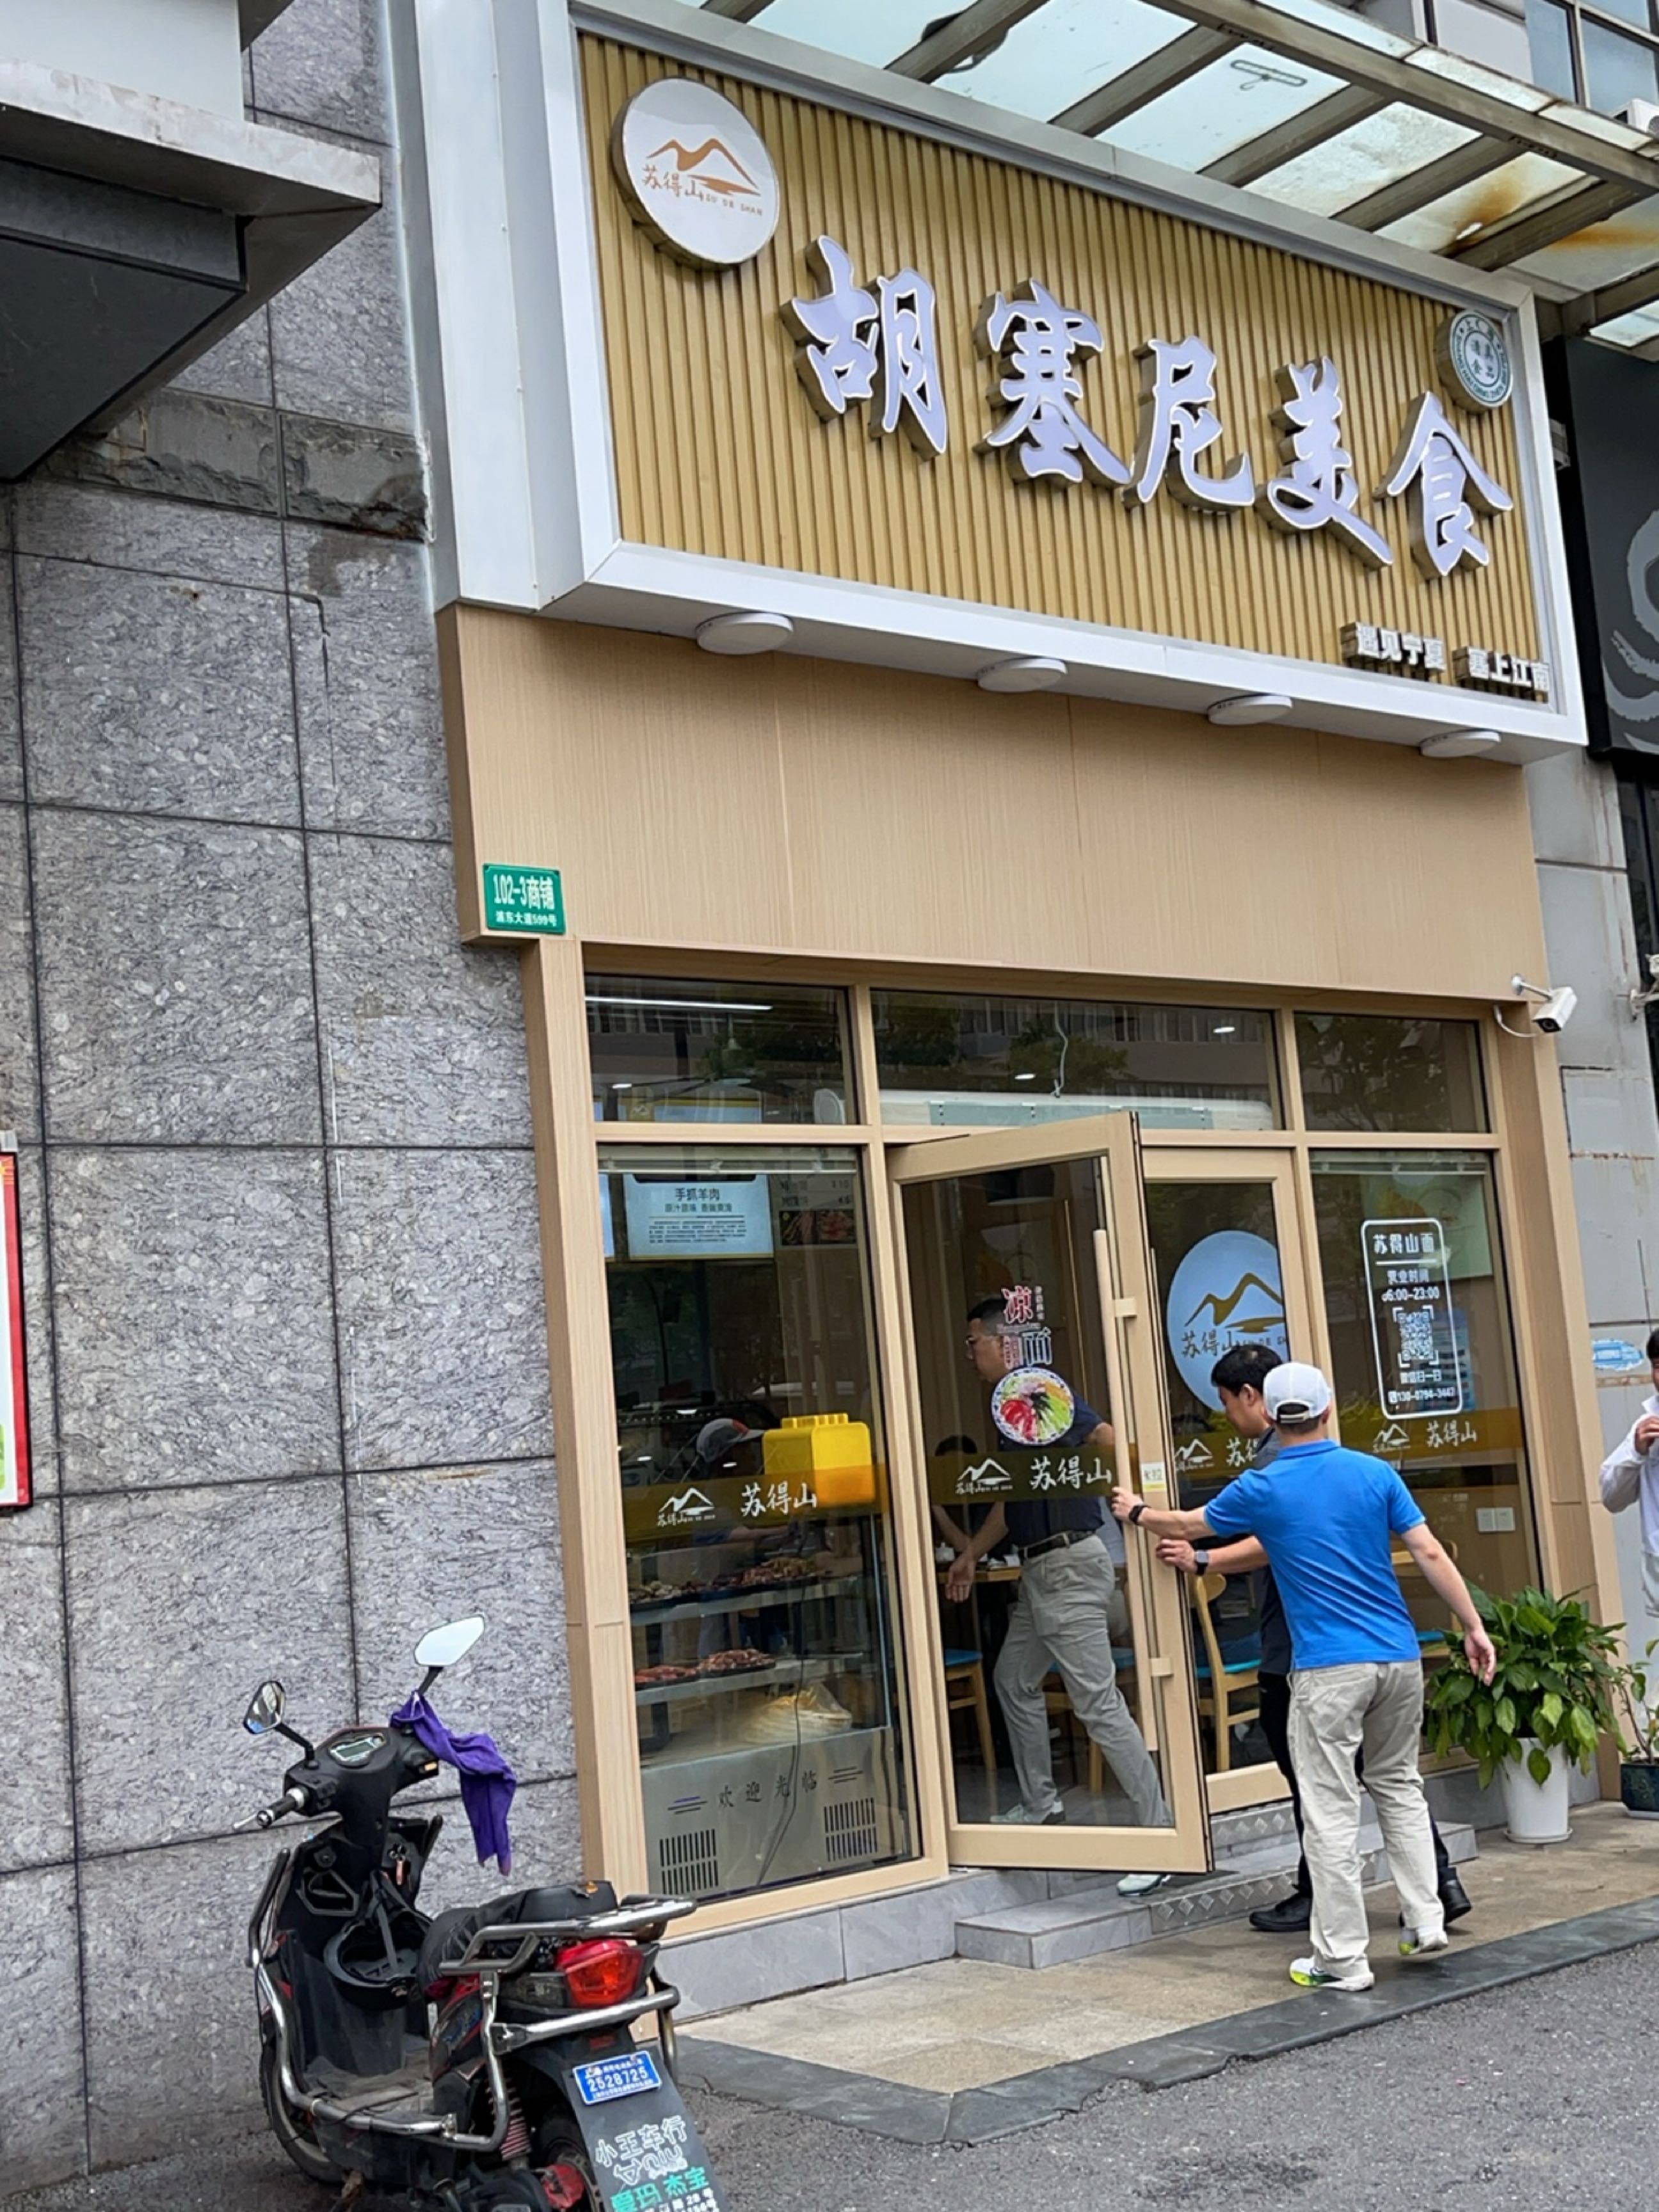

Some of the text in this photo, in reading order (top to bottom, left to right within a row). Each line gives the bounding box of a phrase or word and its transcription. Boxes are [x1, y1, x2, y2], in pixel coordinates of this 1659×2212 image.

[641, 164, 703, 203] 苏得山
[792, 234, 1514, 576] 胡塞尼美食
[1355, 621, 1550, 693] 遇见宁夏 塞上江南
[492, 874, 555, 910] 102-3商铺
[675, 1187, 720, 1201] 手抓羊肉
[1426, 1419, 1478, 1449] 苏得山
[1029, 1455, 1112, 1491] 苏得山
[741, 1480, 817, 1518] 苏得山
[718, 1769, 817, 1807] 欢迎光临
[586, 2066, 649, 2092] 2528725
[595, 2114, 688, 2168] 小王车行
